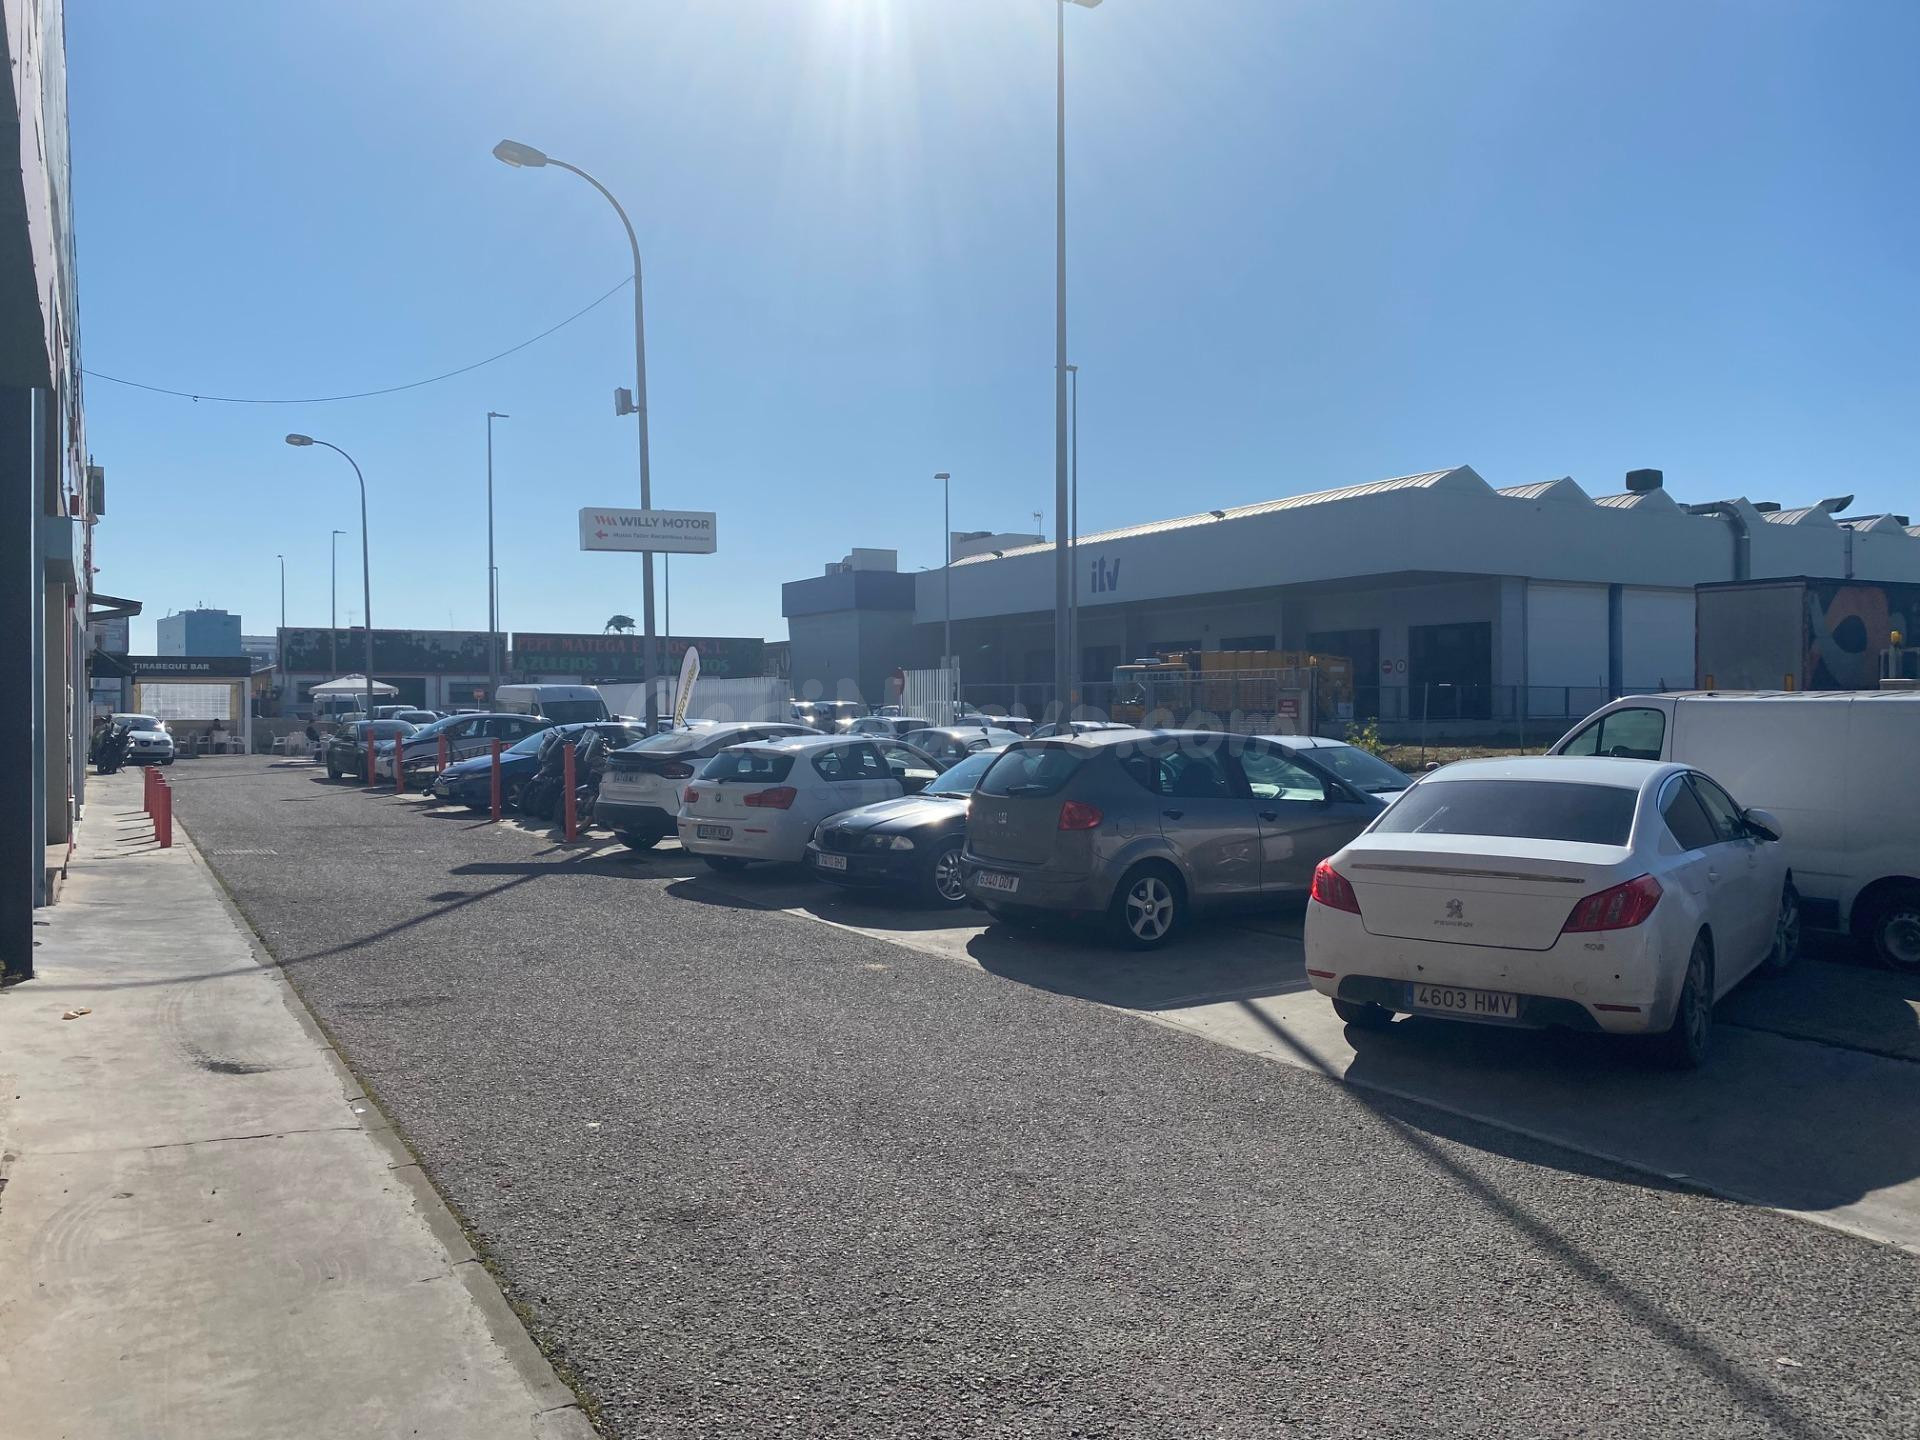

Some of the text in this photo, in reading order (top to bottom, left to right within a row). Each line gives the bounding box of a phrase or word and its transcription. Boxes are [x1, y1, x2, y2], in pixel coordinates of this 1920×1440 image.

[619, 516, 710, 530] WILLY MOTOR
[611, 657, 621, 672] Y
[1418, 987, 1512, 1014] 4603 HMV
